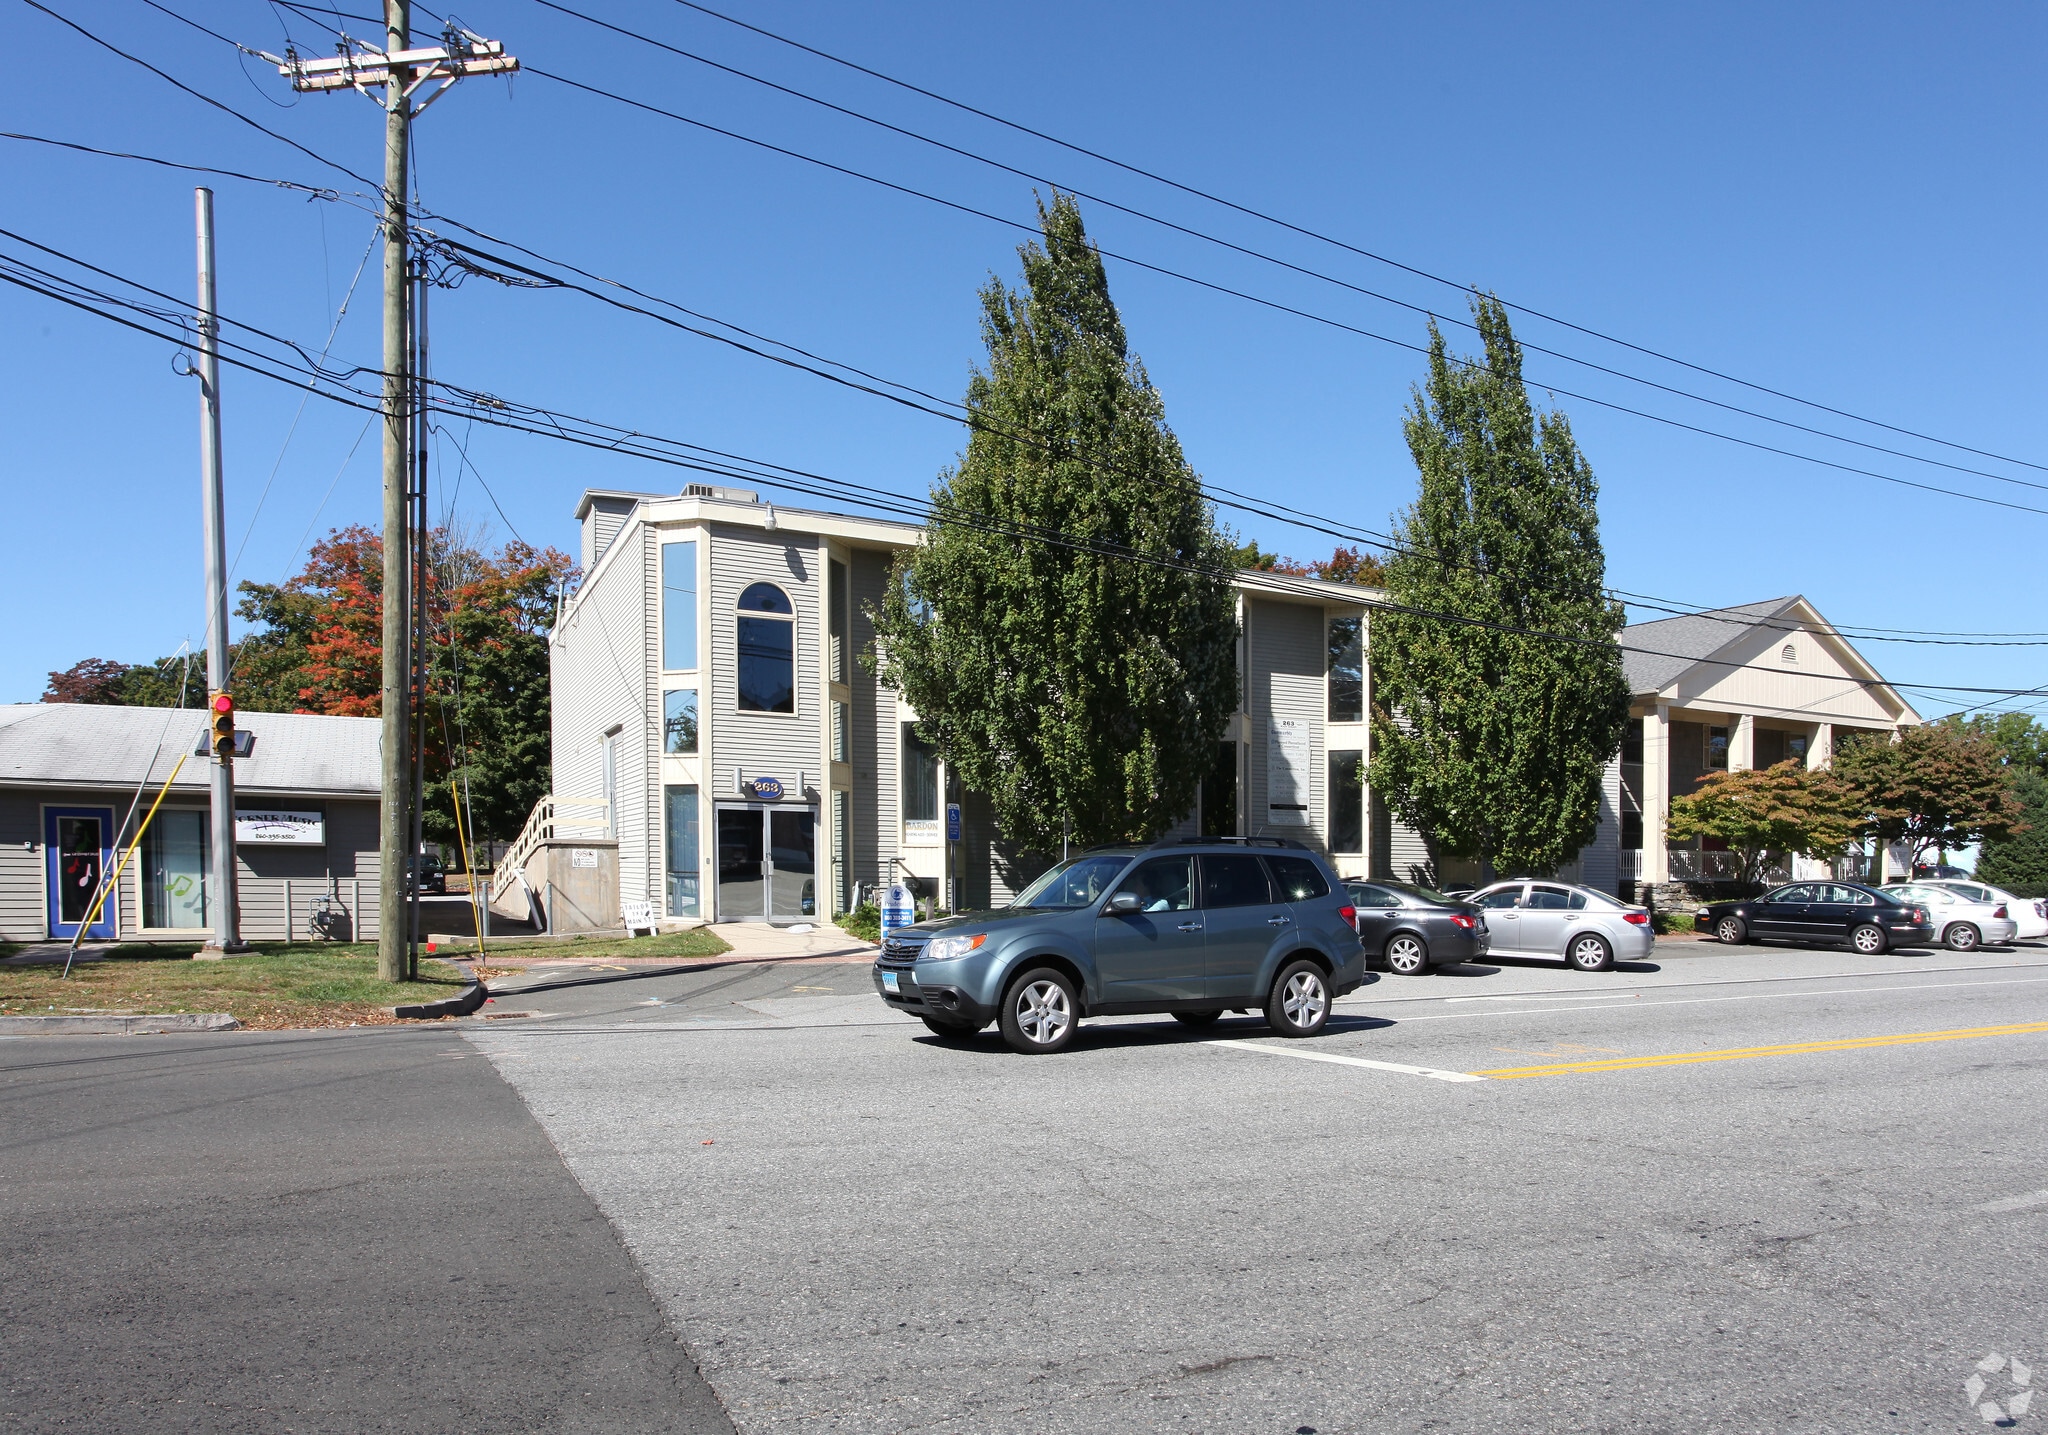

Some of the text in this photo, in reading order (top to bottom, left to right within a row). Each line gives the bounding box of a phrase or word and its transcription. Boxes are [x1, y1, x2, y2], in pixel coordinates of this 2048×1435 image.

[754, 781, 779, 792] 263
[235, 814, 280, 823] ORNER
[624, 902, 649, 911] TAILOR
